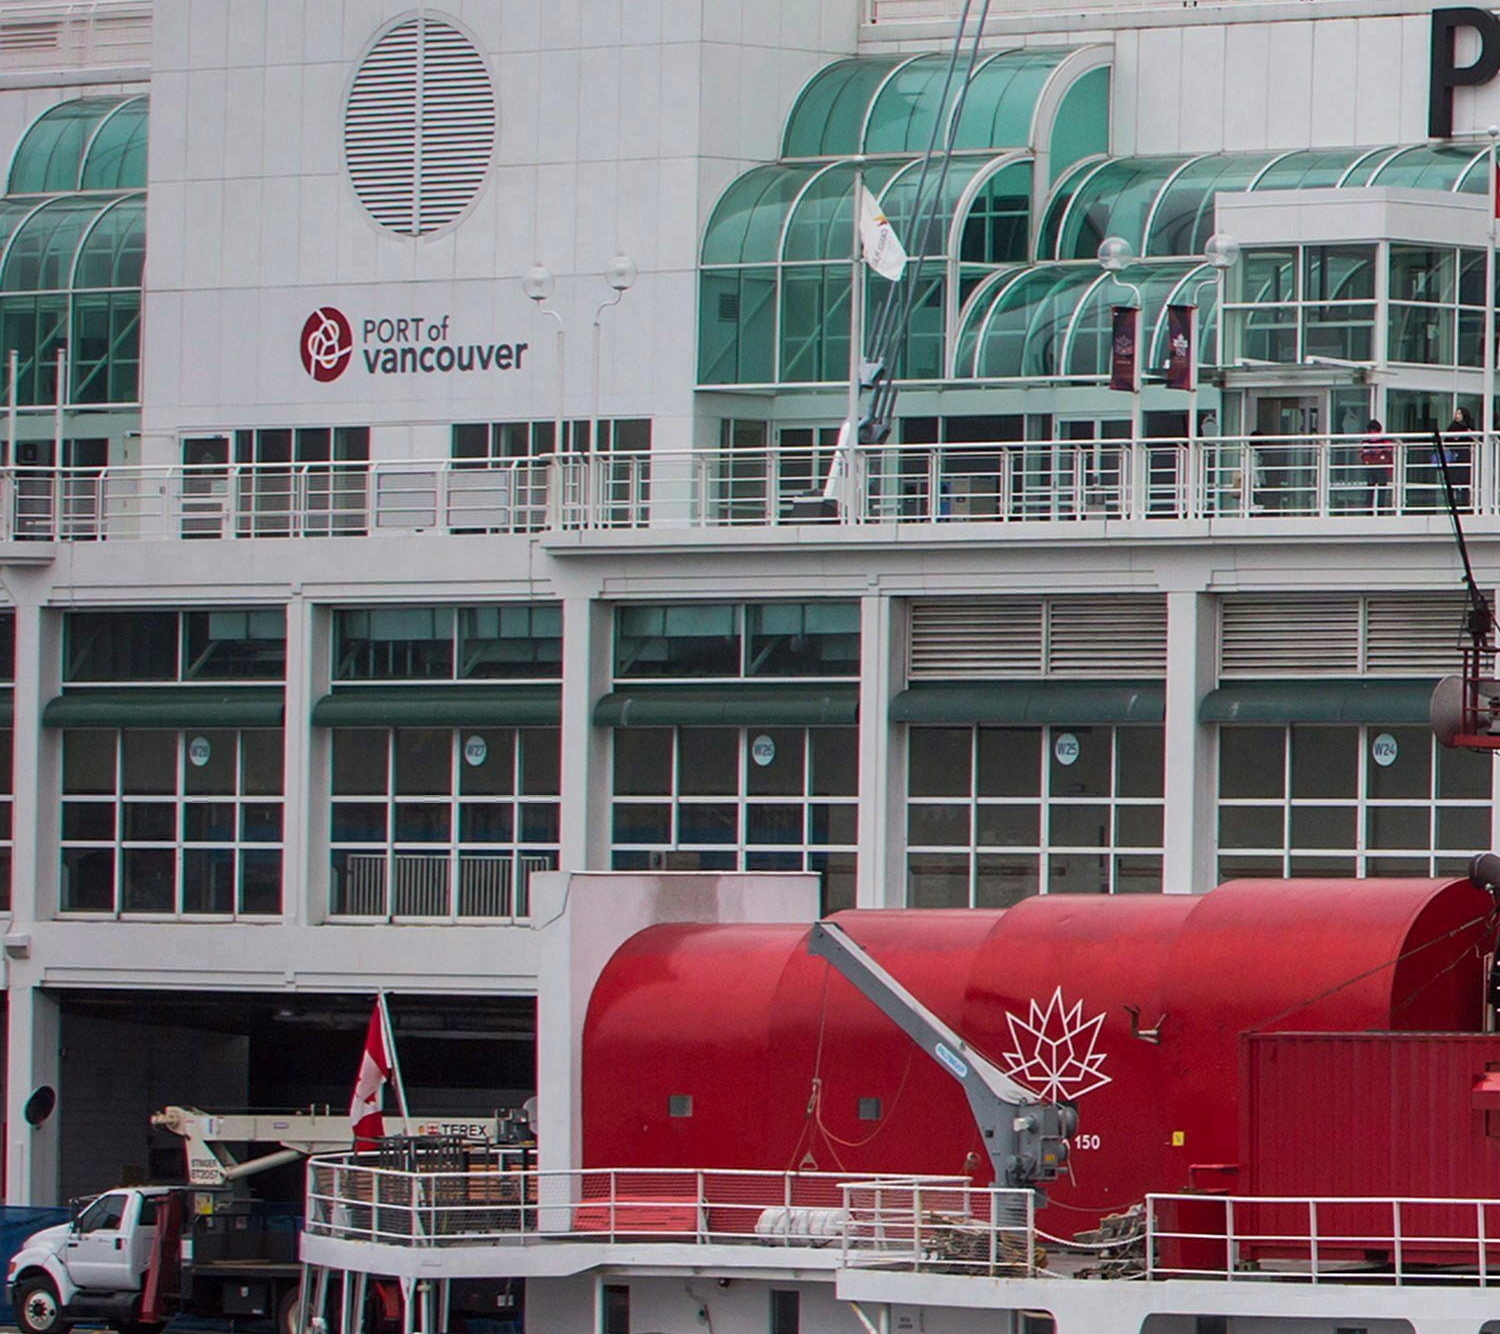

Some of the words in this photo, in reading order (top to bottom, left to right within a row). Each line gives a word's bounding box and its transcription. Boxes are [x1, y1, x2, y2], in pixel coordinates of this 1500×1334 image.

[364, 320, 425, 343] PORT
[428, 316, 449, 342] of
[363, 341, 528, 375] vancouver
[1057, 742, 1078, 756] W25
[1374, 743, 1396, 756] W24
[442, 1123, 487, 1137] TEREX
[1075, 1135, 1101, 1150] 150
